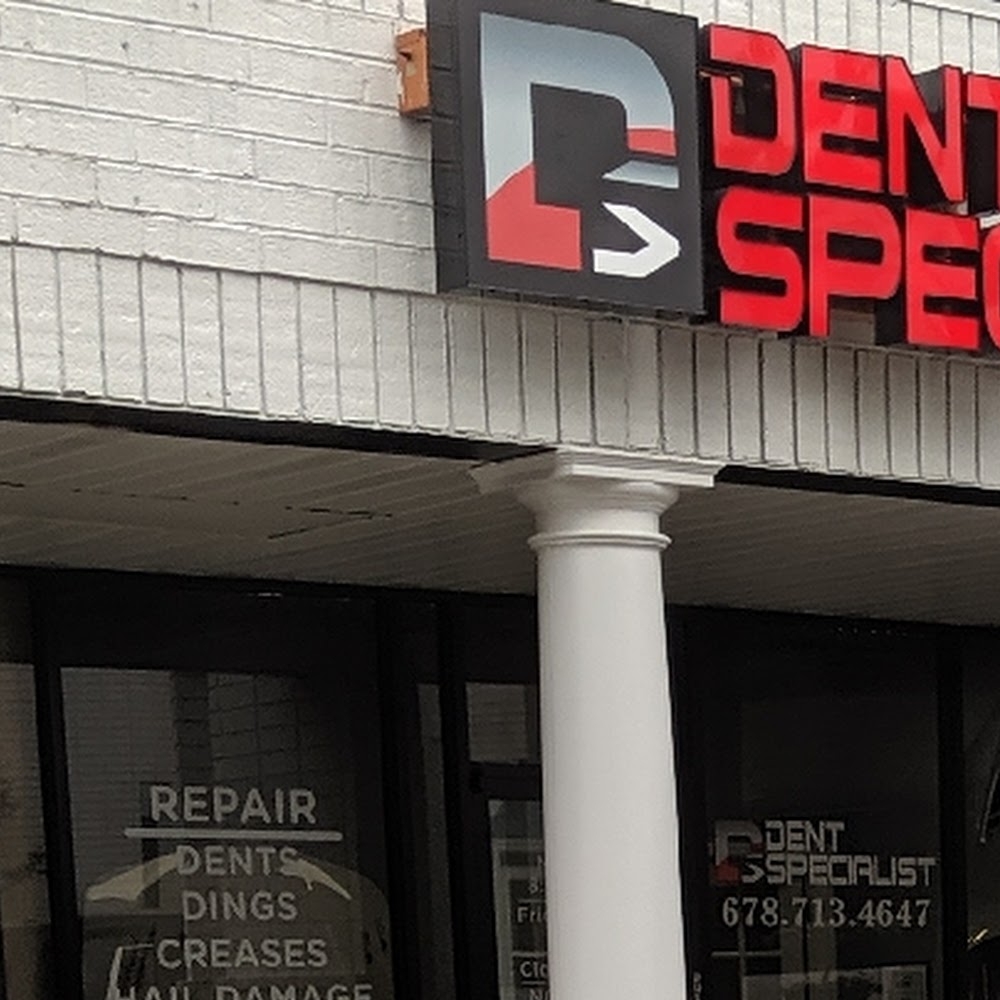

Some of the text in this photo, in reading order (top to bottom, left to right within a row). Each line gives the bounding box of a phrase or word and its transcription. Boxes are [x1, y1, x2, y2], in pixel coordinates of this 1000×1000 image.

[149, 784, 317, 825] REPAIR
[764, 819, 845, 853] DENT
[175, 845, 300, 877] DENTS
[765, 852, 937, 887] SPECIALIST
[181, 890, 299, 922] DINGS
[721, 895, 932, 929] 678.713.4647
[155, 938, 329, 969] CREASES
